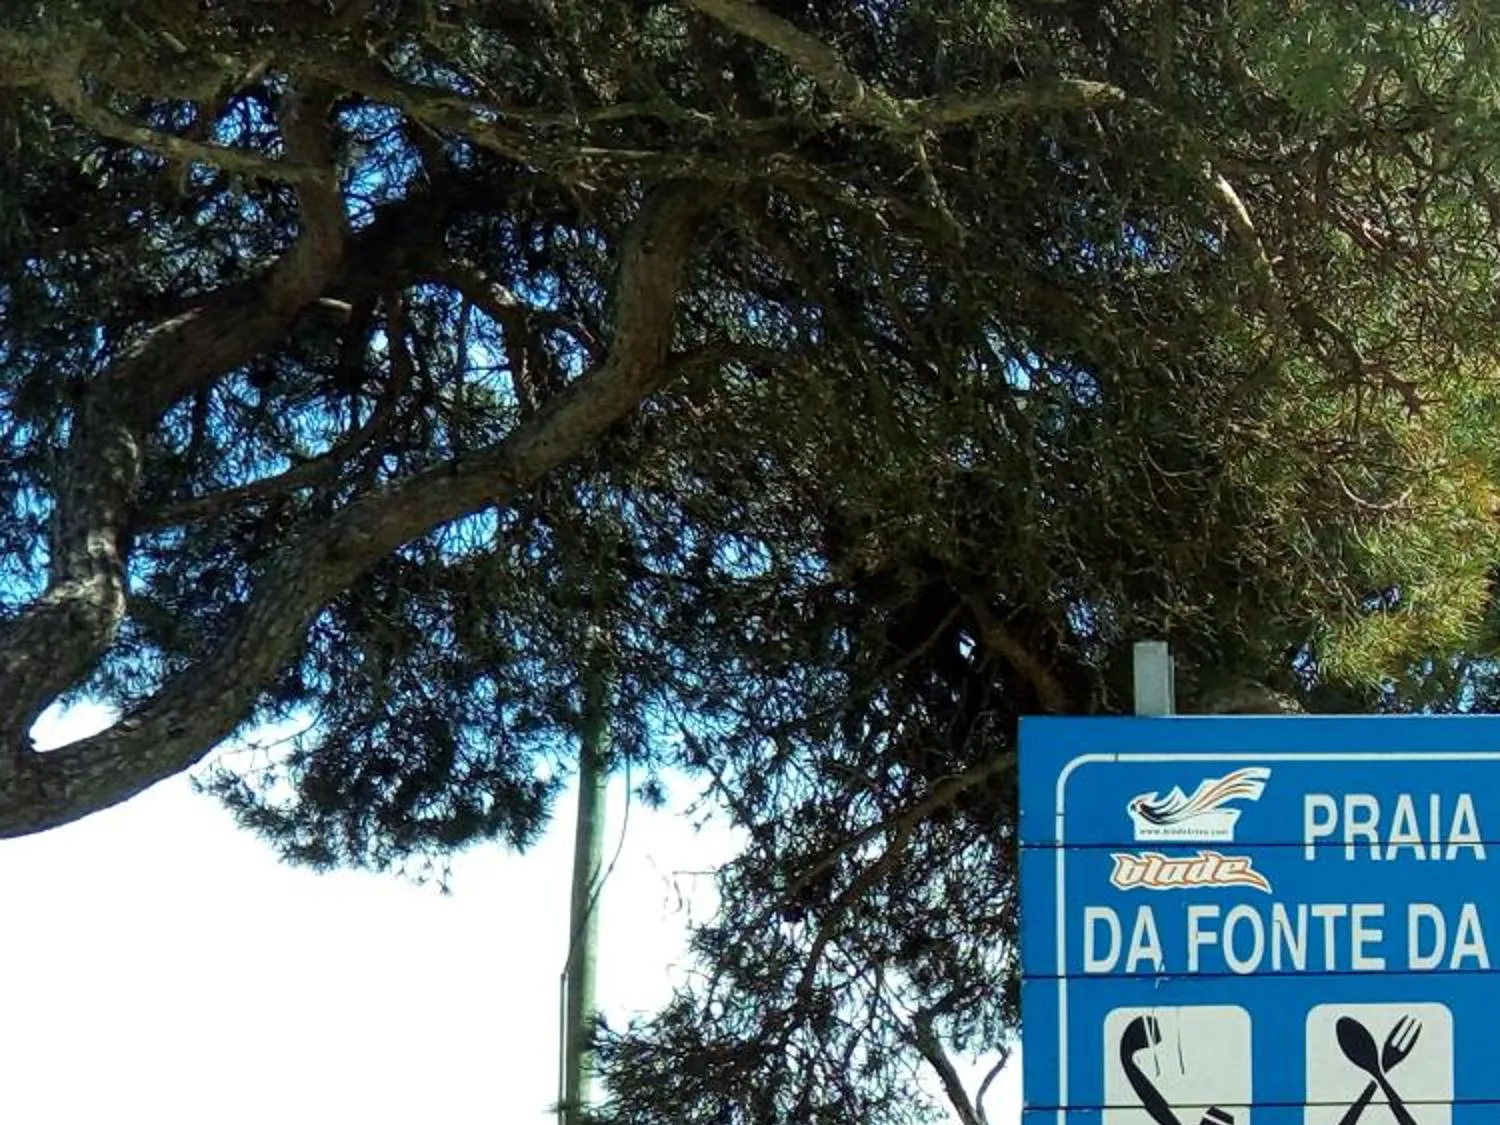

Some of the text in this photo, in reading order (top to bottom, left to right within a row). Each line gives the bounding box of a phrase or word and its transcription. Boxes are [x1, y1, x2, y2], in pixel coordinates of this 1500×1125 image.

[1303, 793, 1487, 861] PRAIA
[1114, 853, 1268, 889] blade
[1083, 904, 1166, 974] DA
[1187, 902, 1386, 975] FONTE
[1407, 902, 1491, 970] DA
